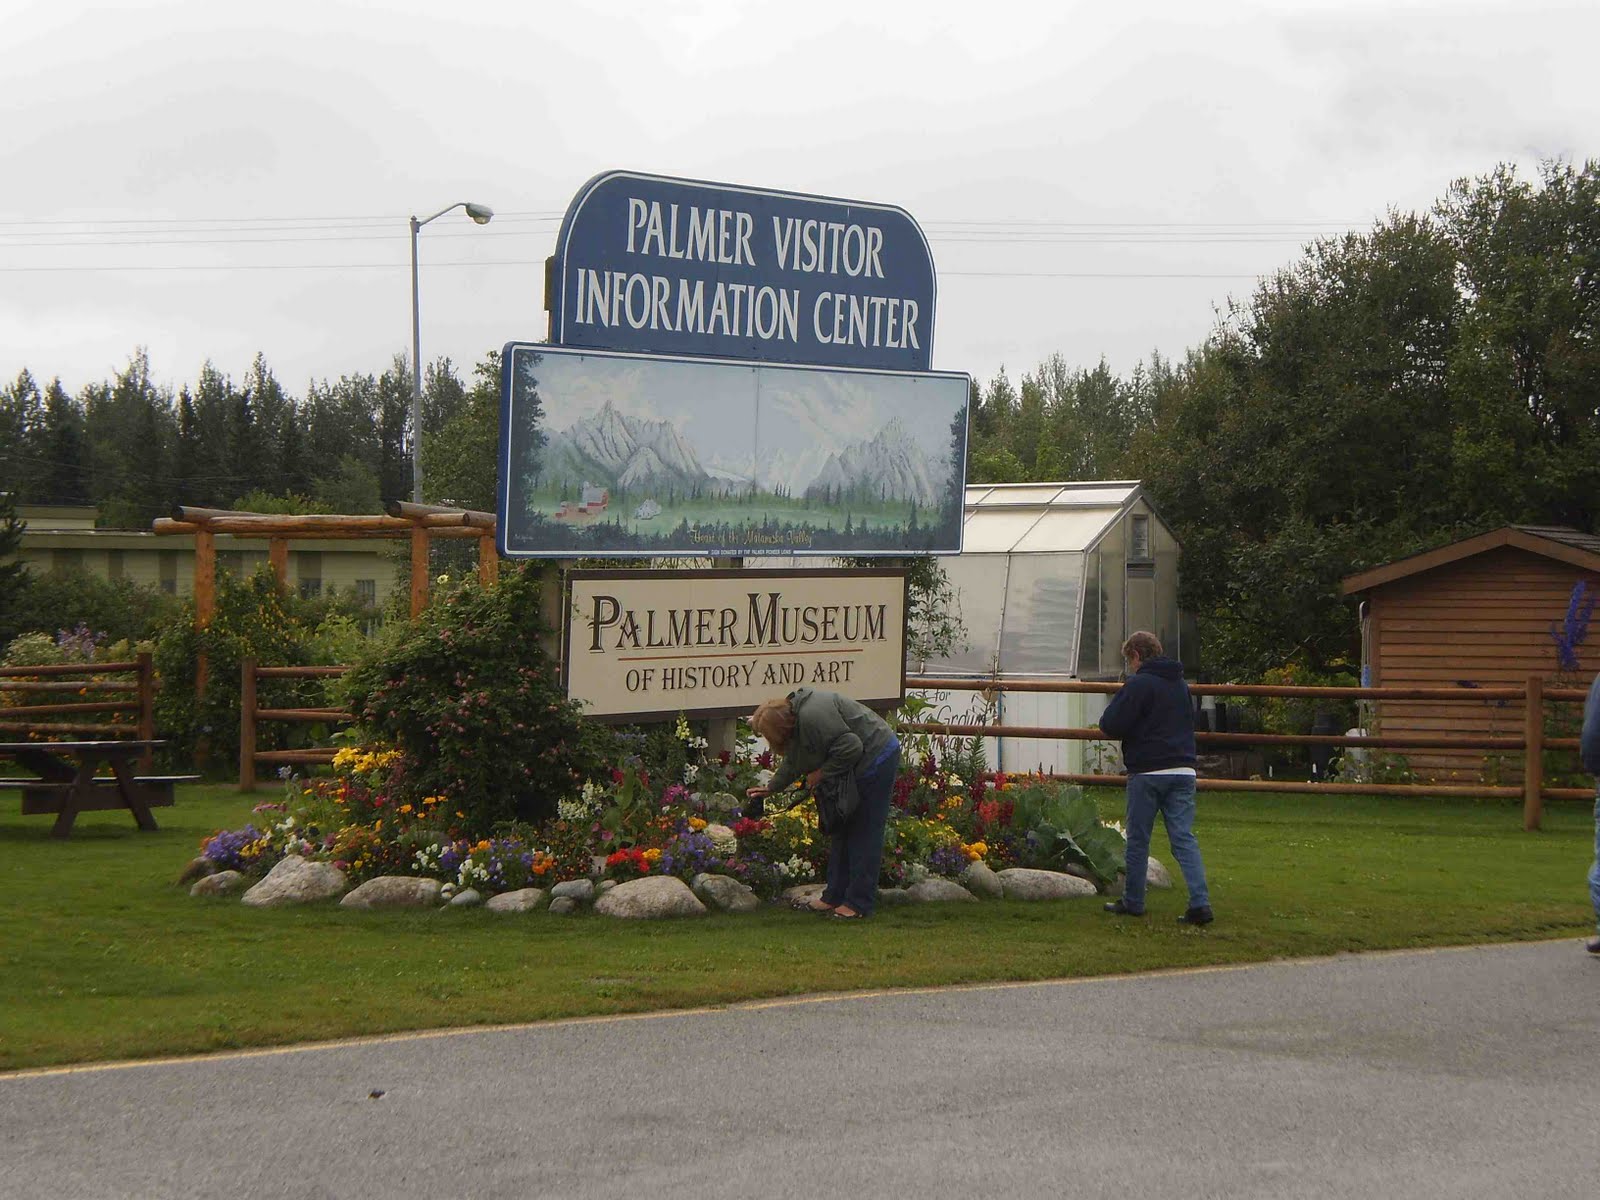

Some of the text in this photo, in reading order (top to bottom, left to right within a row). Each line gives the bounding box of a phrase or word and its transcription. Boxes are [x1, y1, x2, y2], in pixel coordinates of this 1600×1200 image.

[626, 197, 885, 279] PALMER VISITOR
[575, 268, 920, 350] INFORMATION CENTER
[717, 529, 727, 548] of
[729, 529, 739, 545] the
[588, 592, 888, 654] PALMER MUSEUM
[625, 659, 855, 692] OF HISTORY AND ART
[934, 689, 951, 702] for
